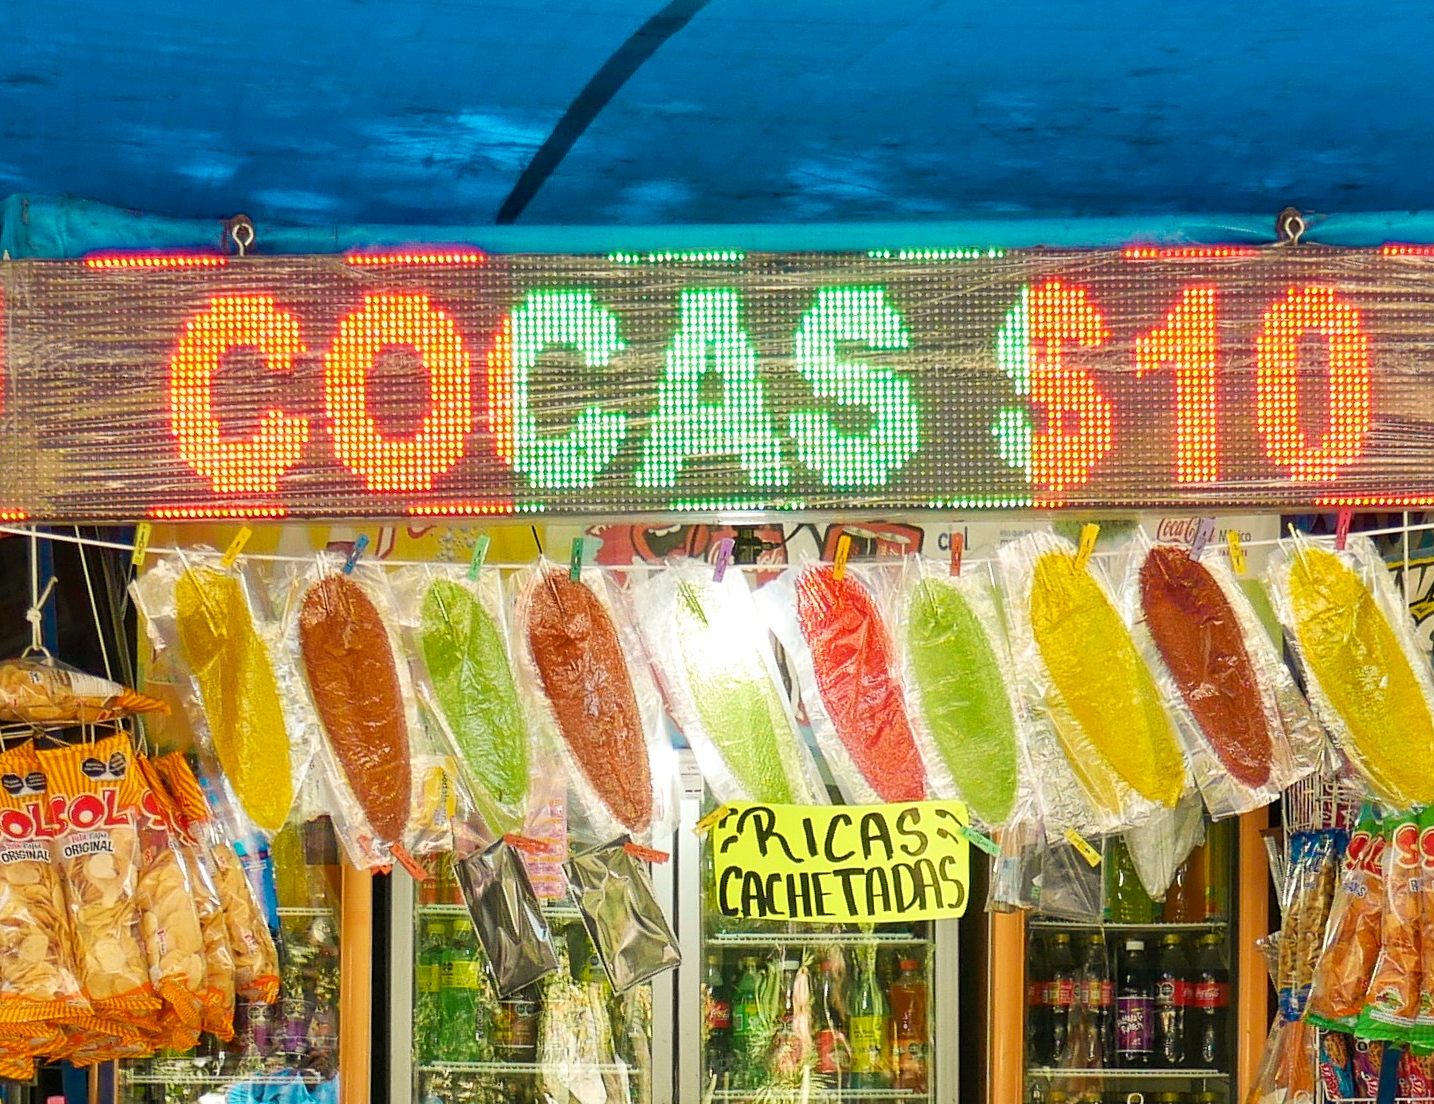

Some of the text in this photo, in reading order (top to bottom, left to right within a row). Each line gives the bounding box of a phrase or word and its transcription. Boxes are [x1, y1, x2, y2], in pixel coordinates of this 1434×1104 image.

[165, 278, 1373, 506] COCAS $10
[53, 791, 135, 832] SOL
[739, 806, 931, 863] RICAS
[1, 849, 51, 862] ORIGINAL
[64, 840, 114, 856] ORIGINAL
[719, 856, 965, 919] CACHETADAS
